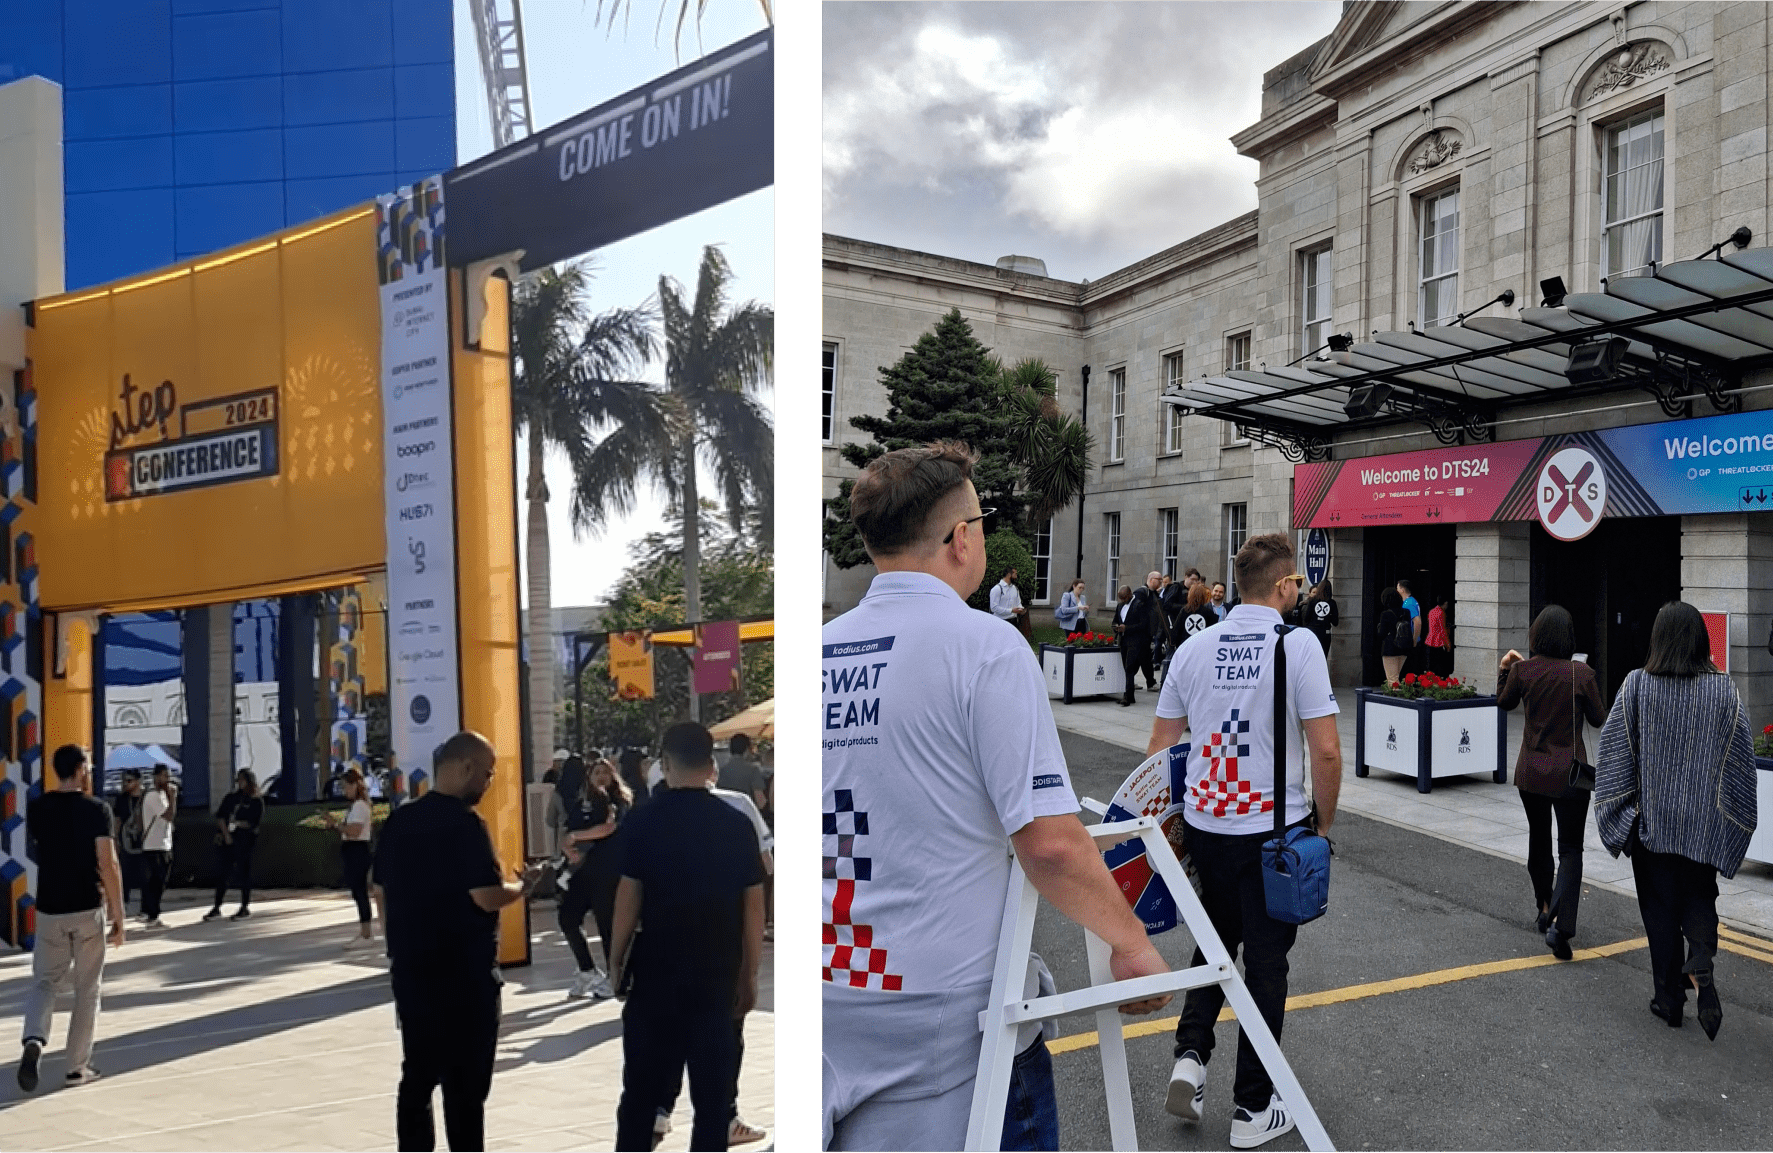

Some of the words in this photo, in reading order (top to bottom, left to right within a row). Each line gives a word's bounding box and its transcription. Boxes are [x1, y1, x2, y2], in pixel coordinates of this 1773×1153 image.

[559, 114, 634, 181] COME
[641, 95, 681, 148] ON
[691, 73, 732, 131] IN!
[109, 373, 176, 450] step
[225, 398, 268, 425] 2024
[136, 435, 258, 484] CONFERENCE
[1361, 468, 1420, 486] Welcome
[1424, 464, 1438, 481] to
[1442, 458, 1490, 480] DTS24
[1699, 469, 1711, 477] GP
[1308, 544, 1326, 555] Main
[1309, 557, 1324, 568] Hall
[1313, 572, 1318, 583] 1
[832, 642, 879, 655] kodius.com
[1216, 647, 1263, 661] SWAT
[1215, 665, 1260, 680] TEAM
[822, 697, 880, 730] EAM
[848, 736, 879, 748] products
[1386, 742, 1397, 751] RDS
[1458, 746, 1471, 754] RDS
[1129, 763, 1156, 791] JACKPOT
[1149, 776, 1162, 790] TEAM
